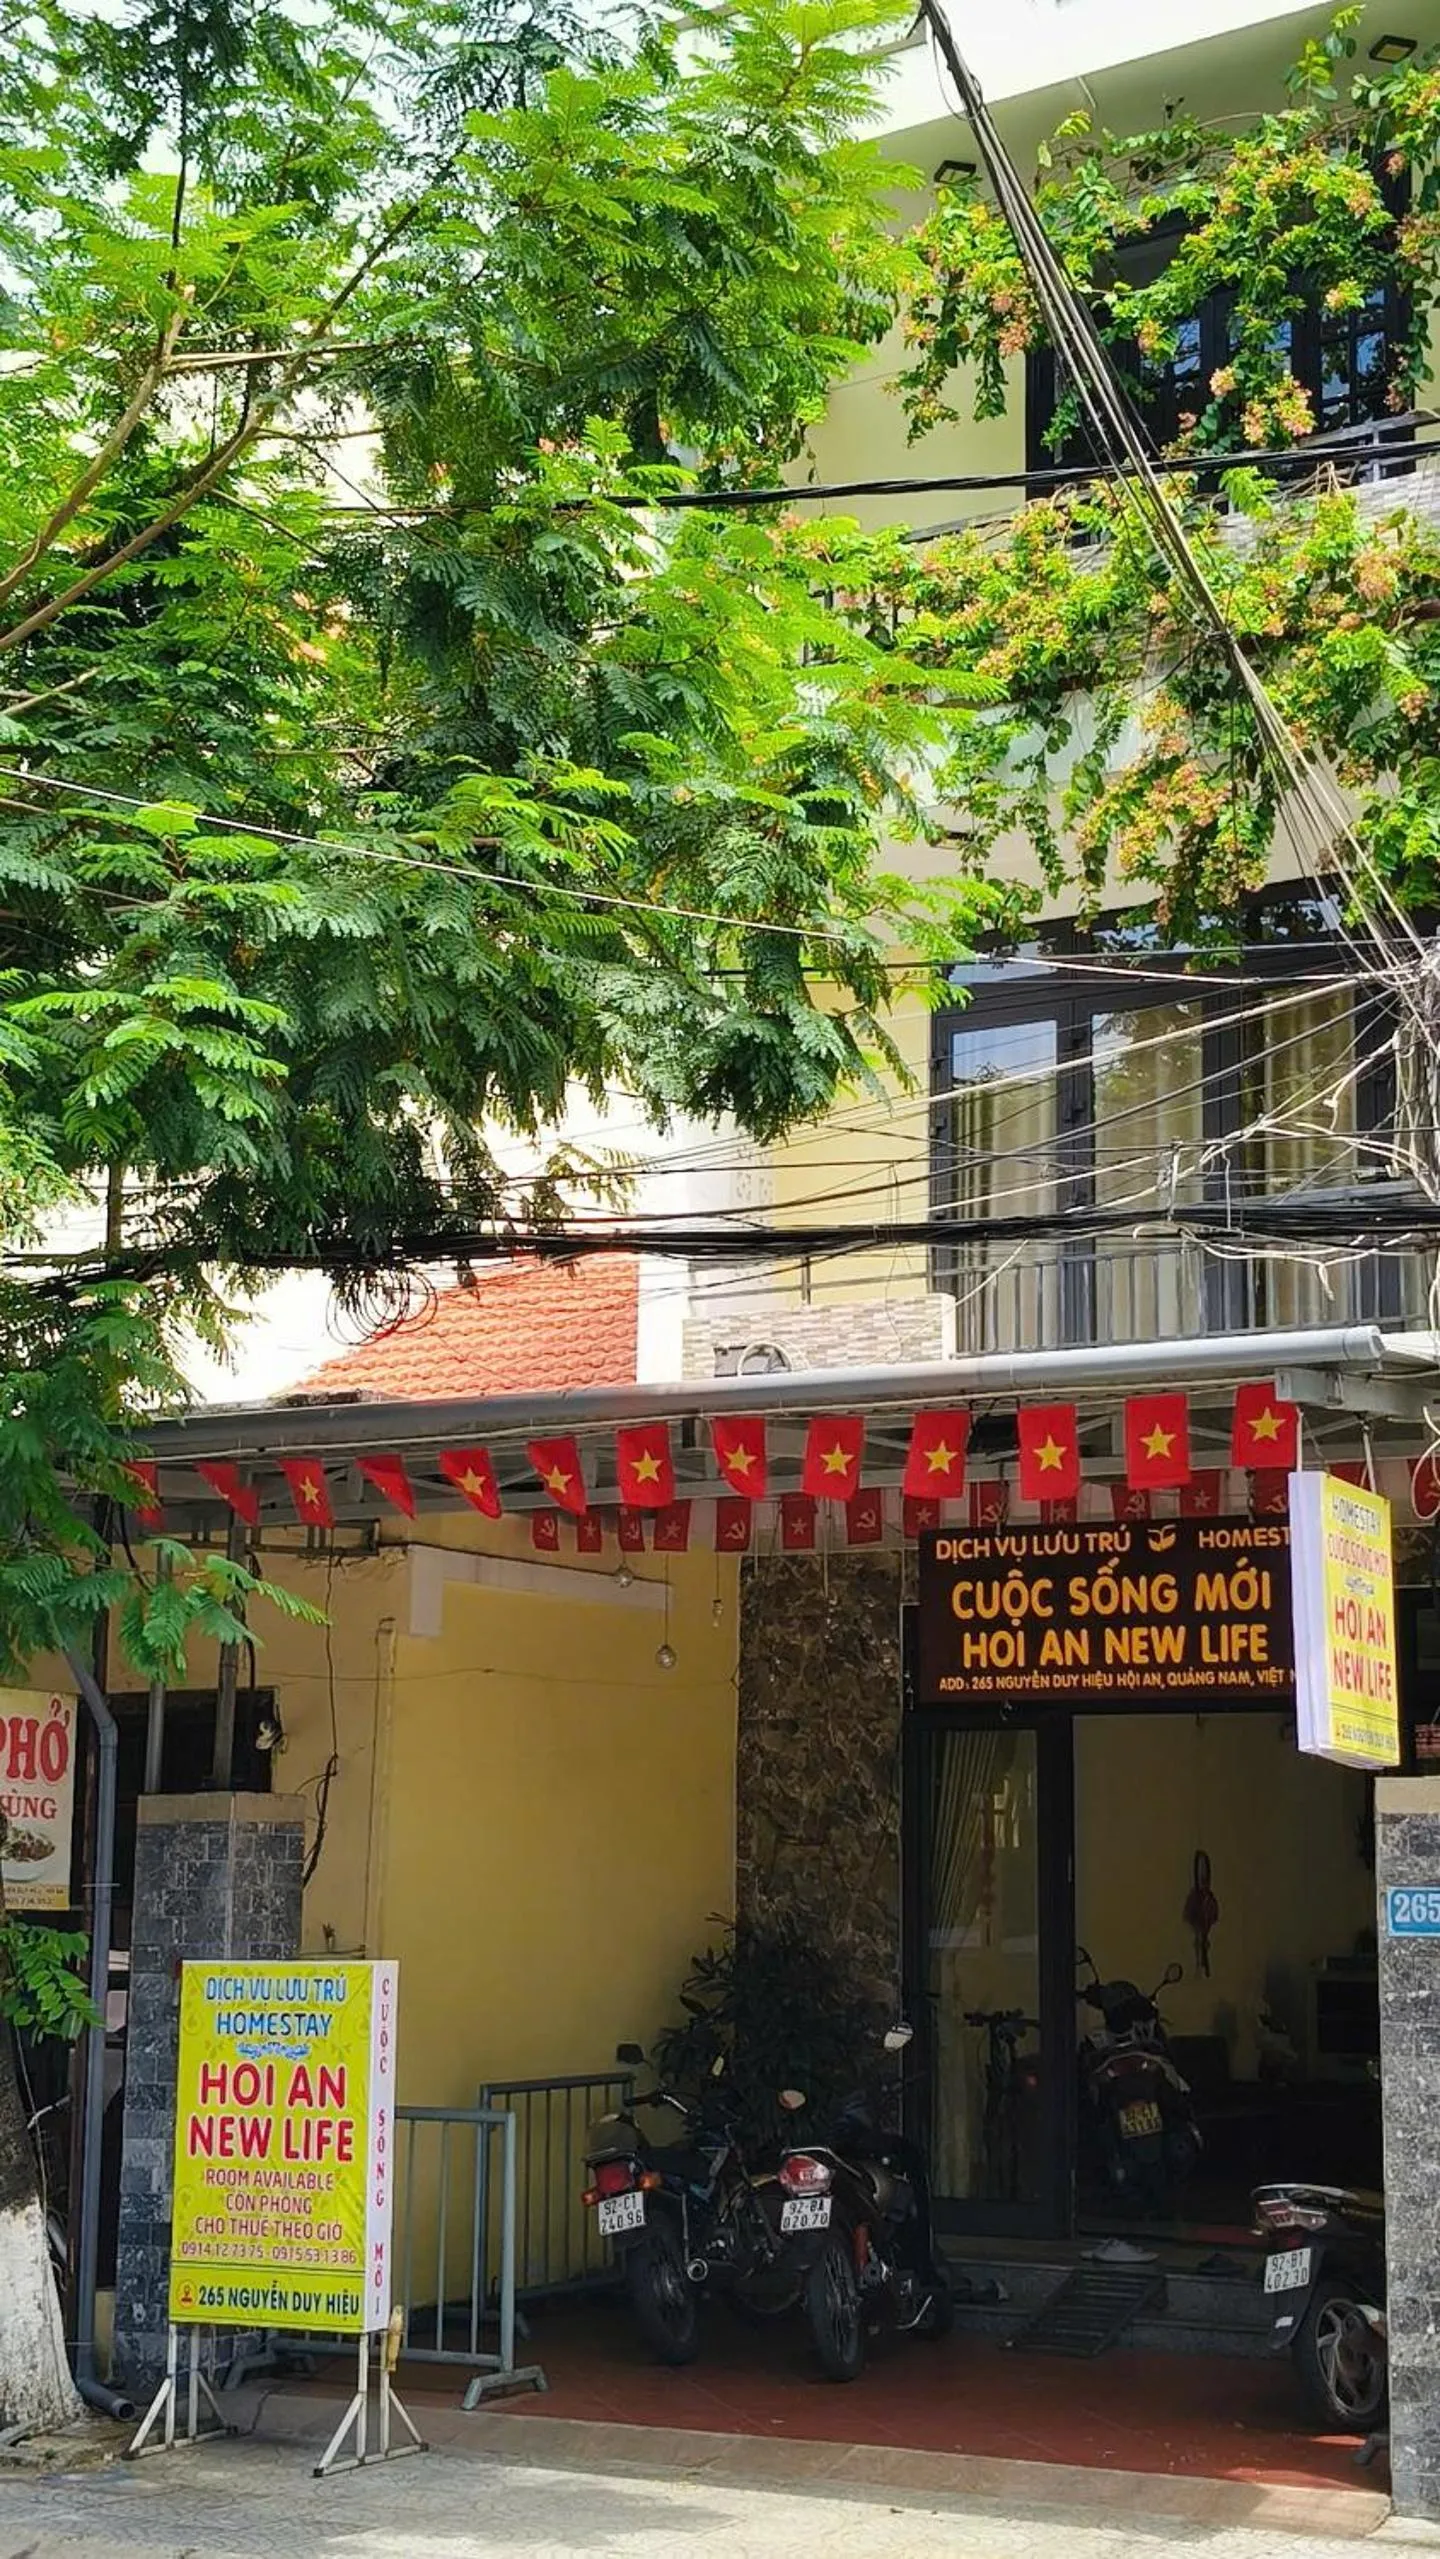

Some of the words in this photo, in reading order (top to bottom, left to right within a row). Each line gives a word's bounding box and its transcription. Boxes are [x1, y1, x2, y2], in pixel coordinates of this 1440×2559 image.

[936, 1537, 990, 1565] DỊCH
[995, 1535, 1027, 1562] VỤ
[1032, 1529, 1079, 1556] LƯU
[1085, 1523, 1131, 1553] TRÚ
[1199, 1526, 1290, 1549] HOMEST
[951, 1568, 1054, 1627] CUỘC
[1068, 1556, 1179, 1616] SỐNG
[1194, 1556, 1271, 1612] MỚI
[1334, 1595, 1363, 1642] HOI
[1366, 1606, 1387, 1649] AN
[963, 1629, 1025, 1669] HOI
[1039, 1627, 1090, 1667] AN
[1104, 1624, 1187, 1665] NEW
[1200, 1623, 1269, 1663] LIFE
[971, 1675, 993, 1690] 265
[1052, 1673, 1079, 1688] DUY
[1082, 1669, 1113, 1690] HIỆU
[1116, 1669, 1140, 1690] HỘI
[1166, 1666, 1216, 1687] QUẢNG
[1255, 1665, 1285, 1688] VIỆT
[1333, 1647, 1364, 1694] NEW
[1366, 1658, 1392, 1702] LIFE
[0, 1698, 70, 1782] HỞ
[1393, 1892, 1440, 1924] 265
[206, 1976, 245, 2006] DỊCH
[250, 1977, 272, 2007] VỤ
[313, 1972, 346, 2003] TRÚ
[216, 2011, 333, 2037] HOMESTAY
[200, 2061, 275, 2107] HOI
[287, 2064, 346, 2109] AN
[189, 2114, 273, 2158] NEW
[284, 2117, 355, 2162] LIFE
[205, 2168, 249, 2186] ROOM
[252, 2170, 335, 2191] AVAILABLE
[195, 2216, 225, 2235] CHO
[273, 2220, 313, 2239] THEO
[198, 2284, 224, 2307] 265
[227, 2279, 289, 2311] NGUYỄN
[292, 2291, 322, 2312] DUY
[325, 2288, 360, 2321] HIỆU
